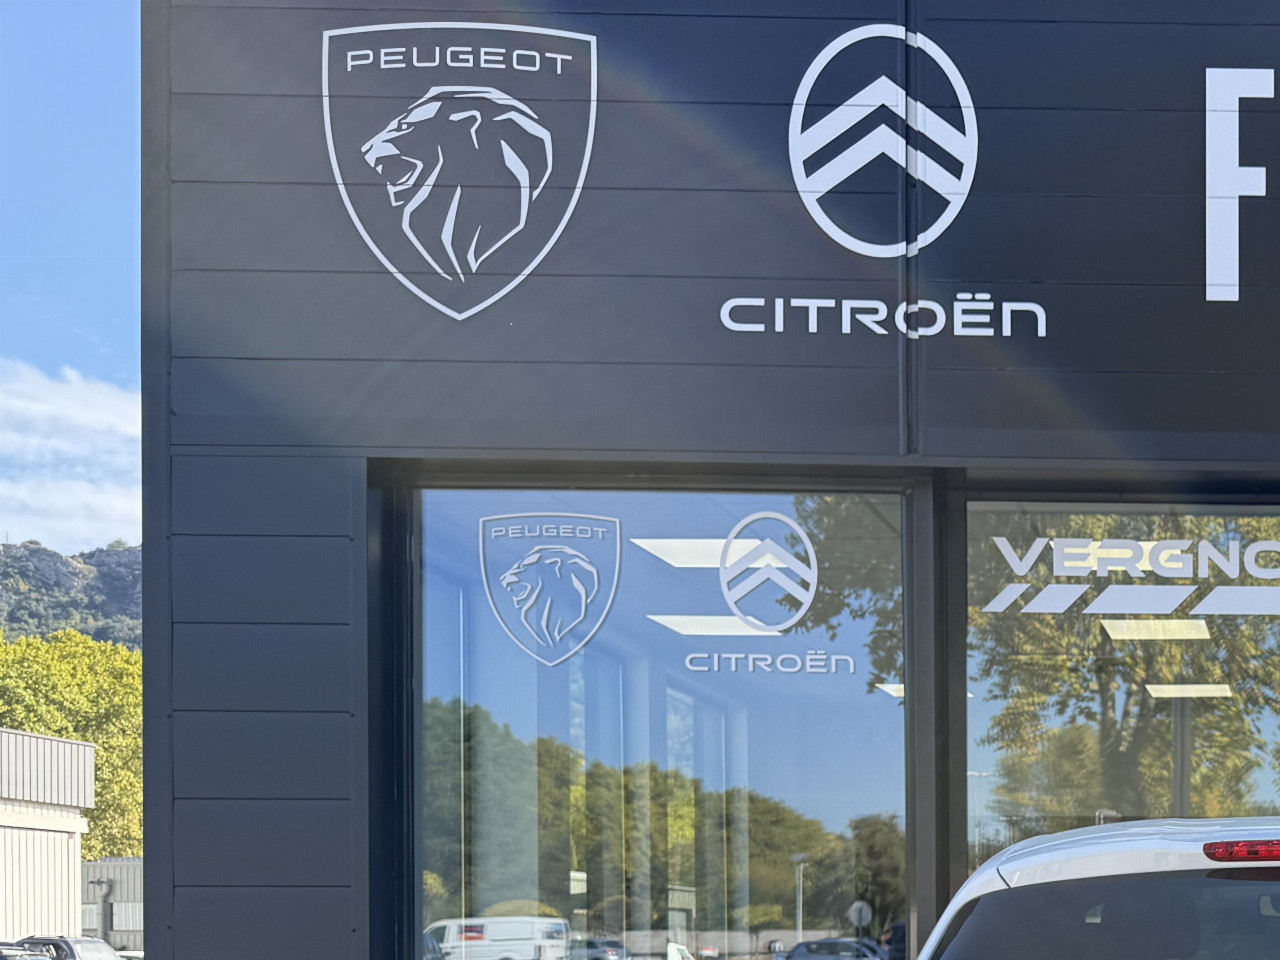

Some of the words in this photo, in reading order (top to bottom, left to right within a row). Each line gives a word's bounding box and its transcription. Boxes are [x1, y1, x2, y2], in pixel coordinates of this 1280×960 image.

[346, 46, 573, 75] PEUGEOT
[720, 292, 1047, 339] CITROËN
[491, 525, 608, 540] PEUGEOT
[685, 650, 856, 674] CITROËN
